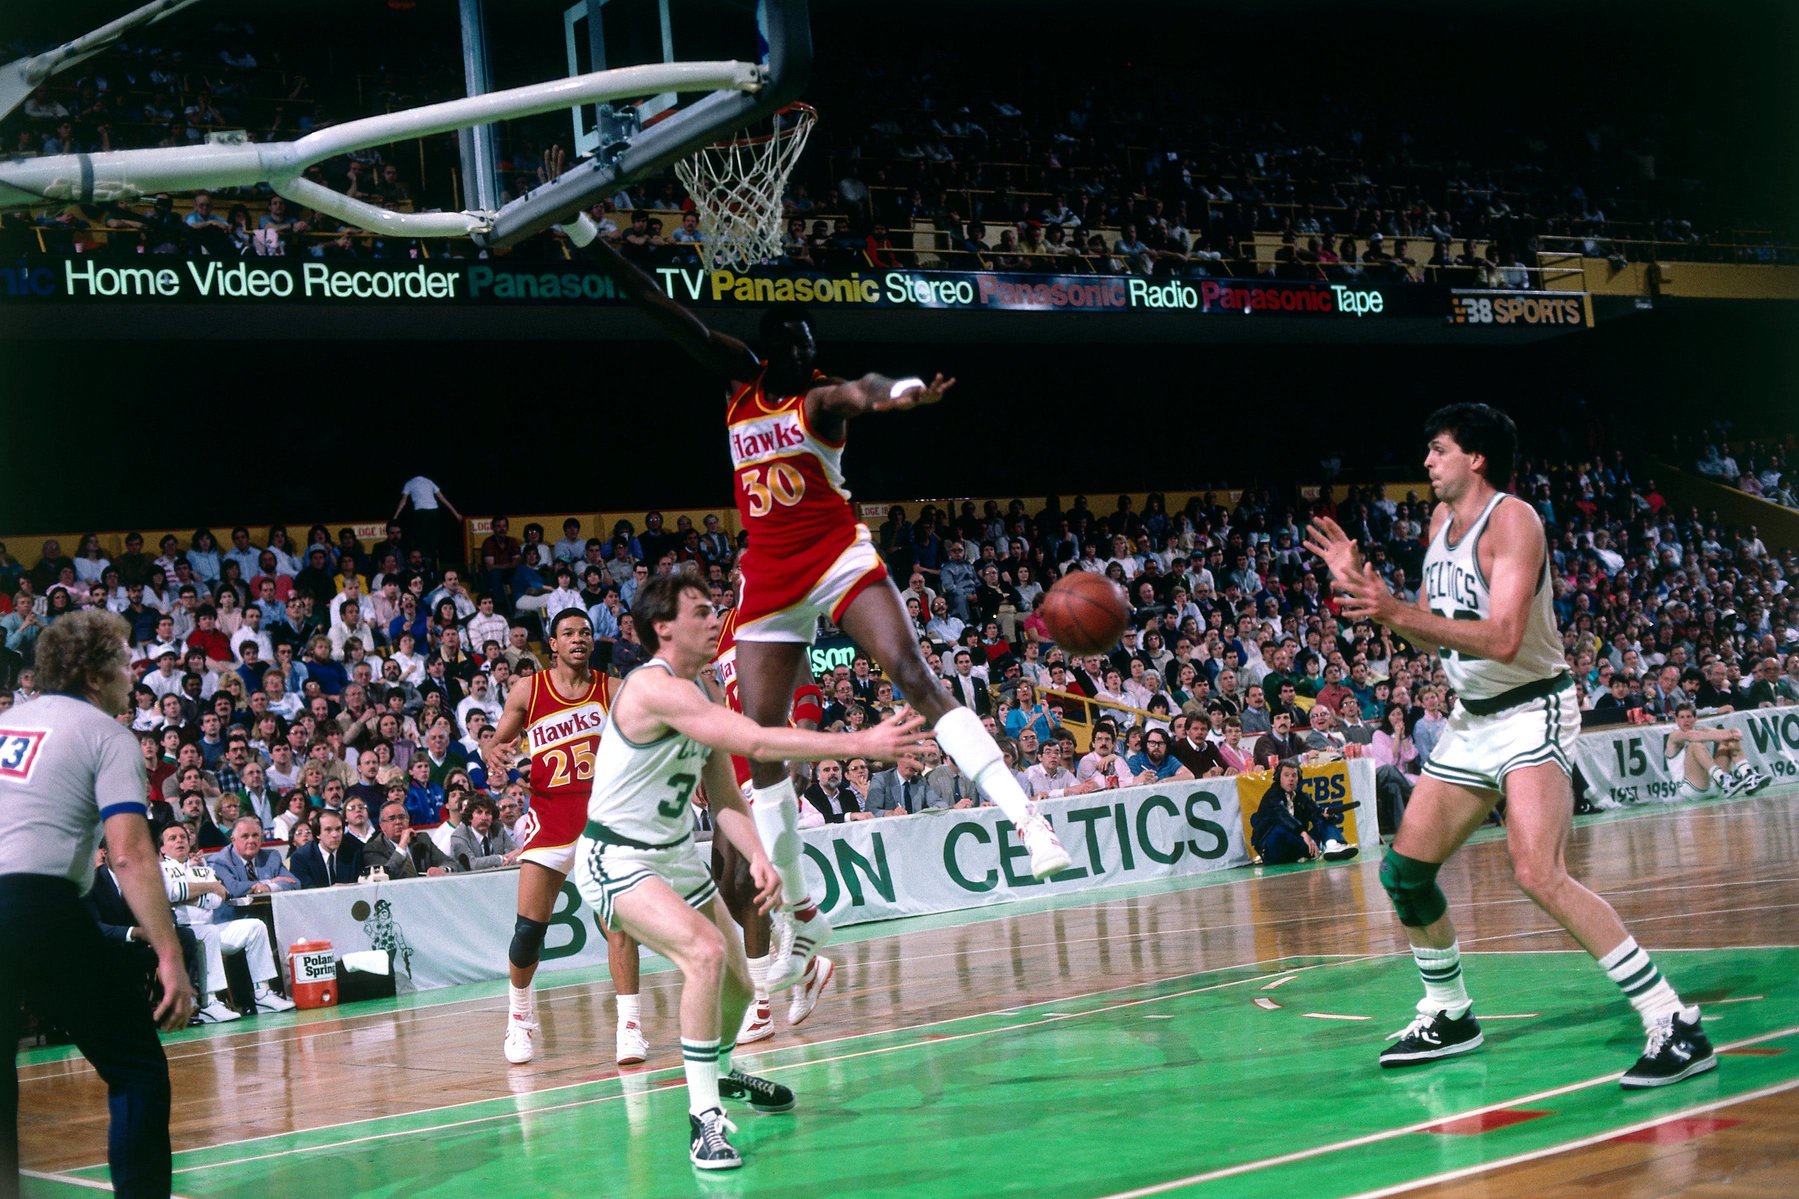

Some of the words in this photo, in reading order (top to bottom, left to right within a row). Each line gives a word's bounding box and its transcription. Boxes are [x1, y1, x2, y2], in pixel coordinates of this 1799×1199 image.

[65, 260, 180, 296] Home
[186, 261, 294, 296] Video
[302, 262, 460, 298] Recorder
[656, 268, 704, 300] TV
[711, 269, 880, 304] Panasonic
[885, 272, 974, 304] Stereo
[977, 275, 1125, 307] Panasonic
[1129, 279, 1198, 309] Radio
[1201, 280, 1332, 312] Panasonic
[1331, 284, 1383, 317] Tape
[1494, 298, 1581, 324] SPORTS
[733, 423, 805, 459] Hawks
[741, 462, 806, 518] 30
[806, 646, 856, 673] son
[532, 711, 602, 749] Hawks
[542, 741, 597, 789] 25
[1612, 737, 1648, 778] 15
[1609, 785, 1640, 802] 1957
[1646, 780, 1677, 798] 1959
